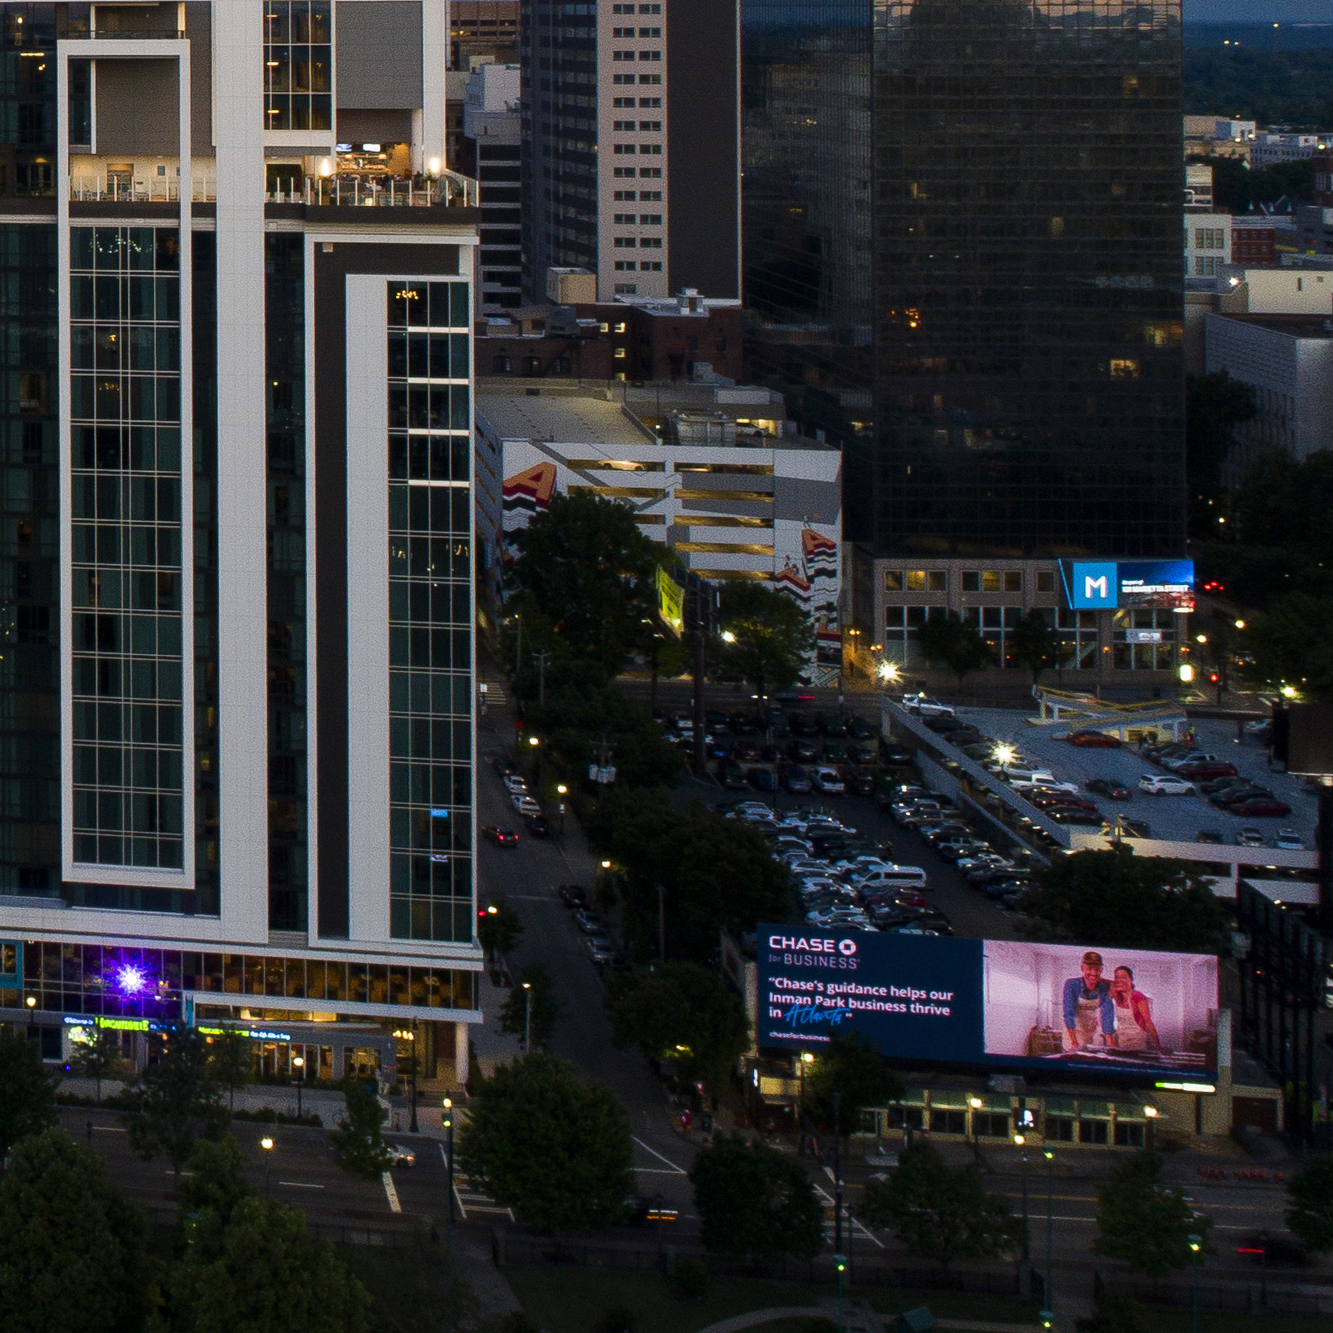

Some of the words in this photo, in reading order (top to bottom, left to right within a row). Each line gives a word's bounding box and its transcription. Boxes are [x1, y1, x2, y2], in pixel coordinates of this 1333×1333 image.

[1085, 575, 1108, 599] M
[769, 935, 835, 952] CHASE
[768, 954, 782, 963] for
[827, 982, 887, 996] guidance
[890, 985, 926, 1001] helps
[930, 991, 954, 1001] our
[769, 992, 811, 1006] Inman
[815, 995, 846, 1008] Park
[848, 997, 906, 1013] business
[910, 1003, 951, 1017] thrive
[769, 1006, 782, 1018] in
